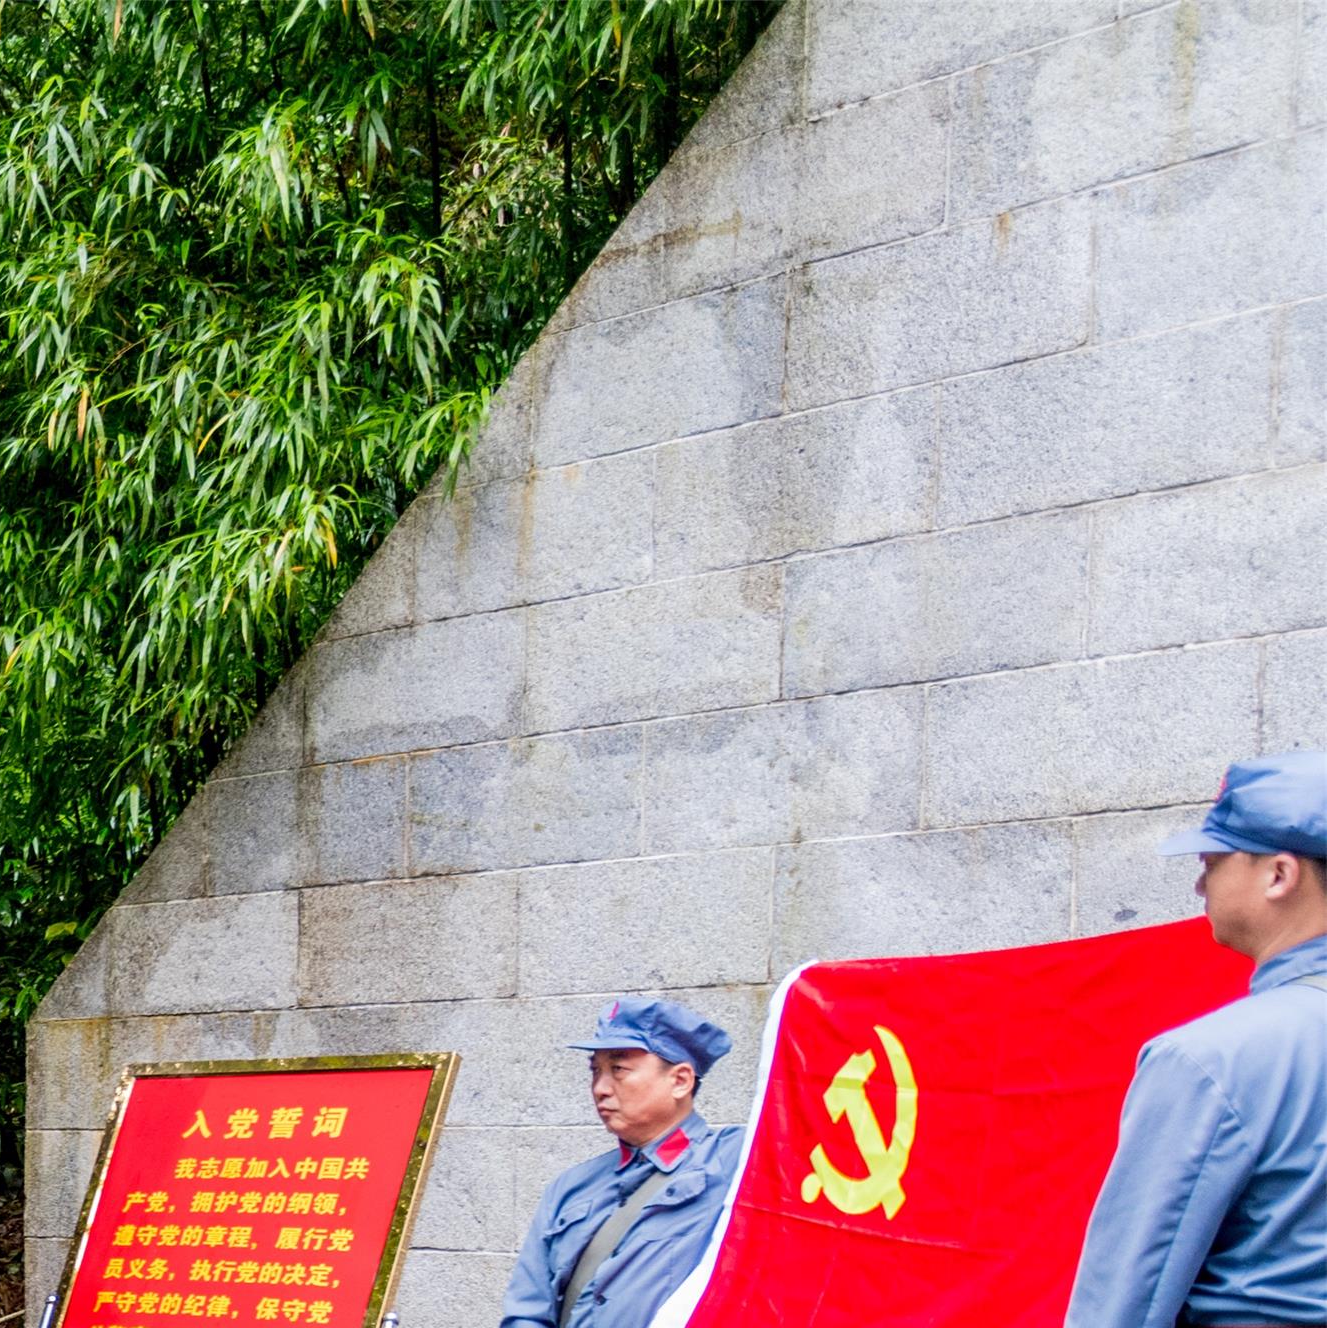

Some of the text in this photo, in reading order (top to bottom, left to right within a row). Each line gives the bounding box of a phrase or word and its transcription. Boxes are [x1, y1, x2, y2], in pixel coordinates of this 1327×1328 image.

[181, 1106, 350, 1140] 入党誓词
[174, 1157, 370, 1180] 我志愿加入中国共
